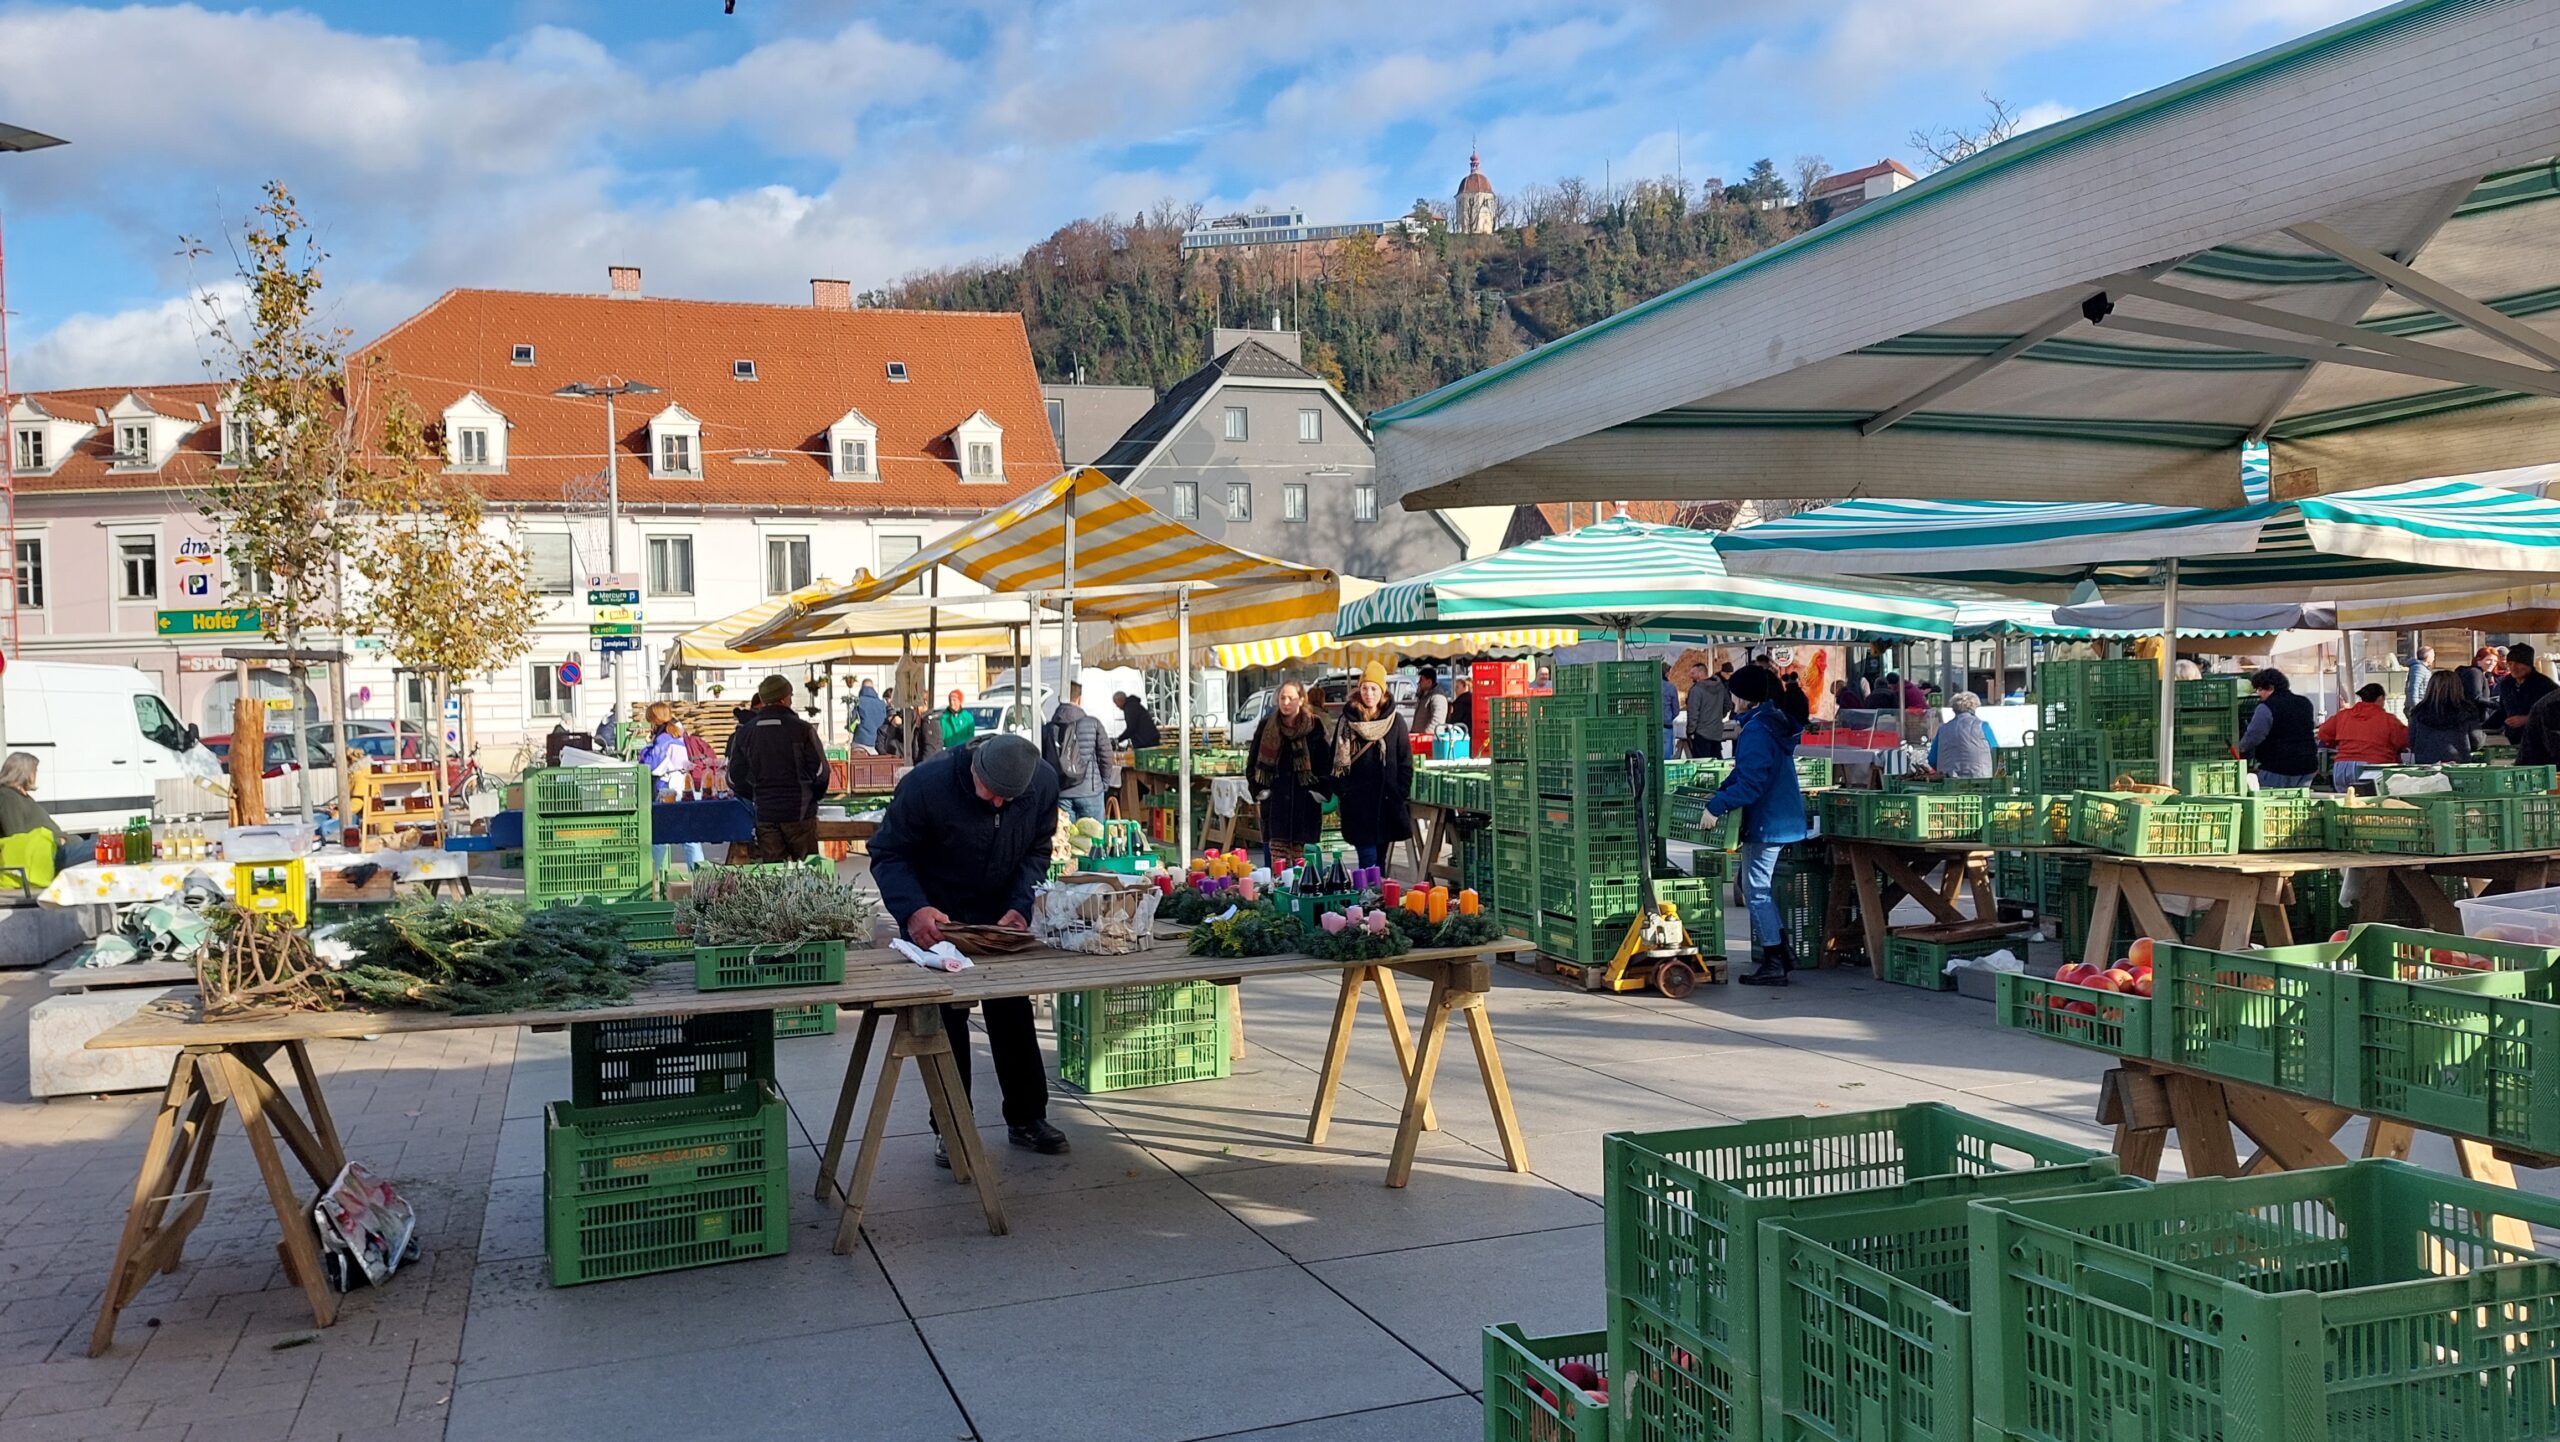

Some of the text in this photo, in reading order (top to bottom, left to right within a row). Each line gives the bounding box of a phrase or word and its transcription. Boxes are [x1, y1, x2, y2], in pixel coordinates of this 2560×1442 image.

[180, 537, 210, 555] dm
[192, 611, 239, 630] Hofer
[190, 657, 246, 672] SPOR
